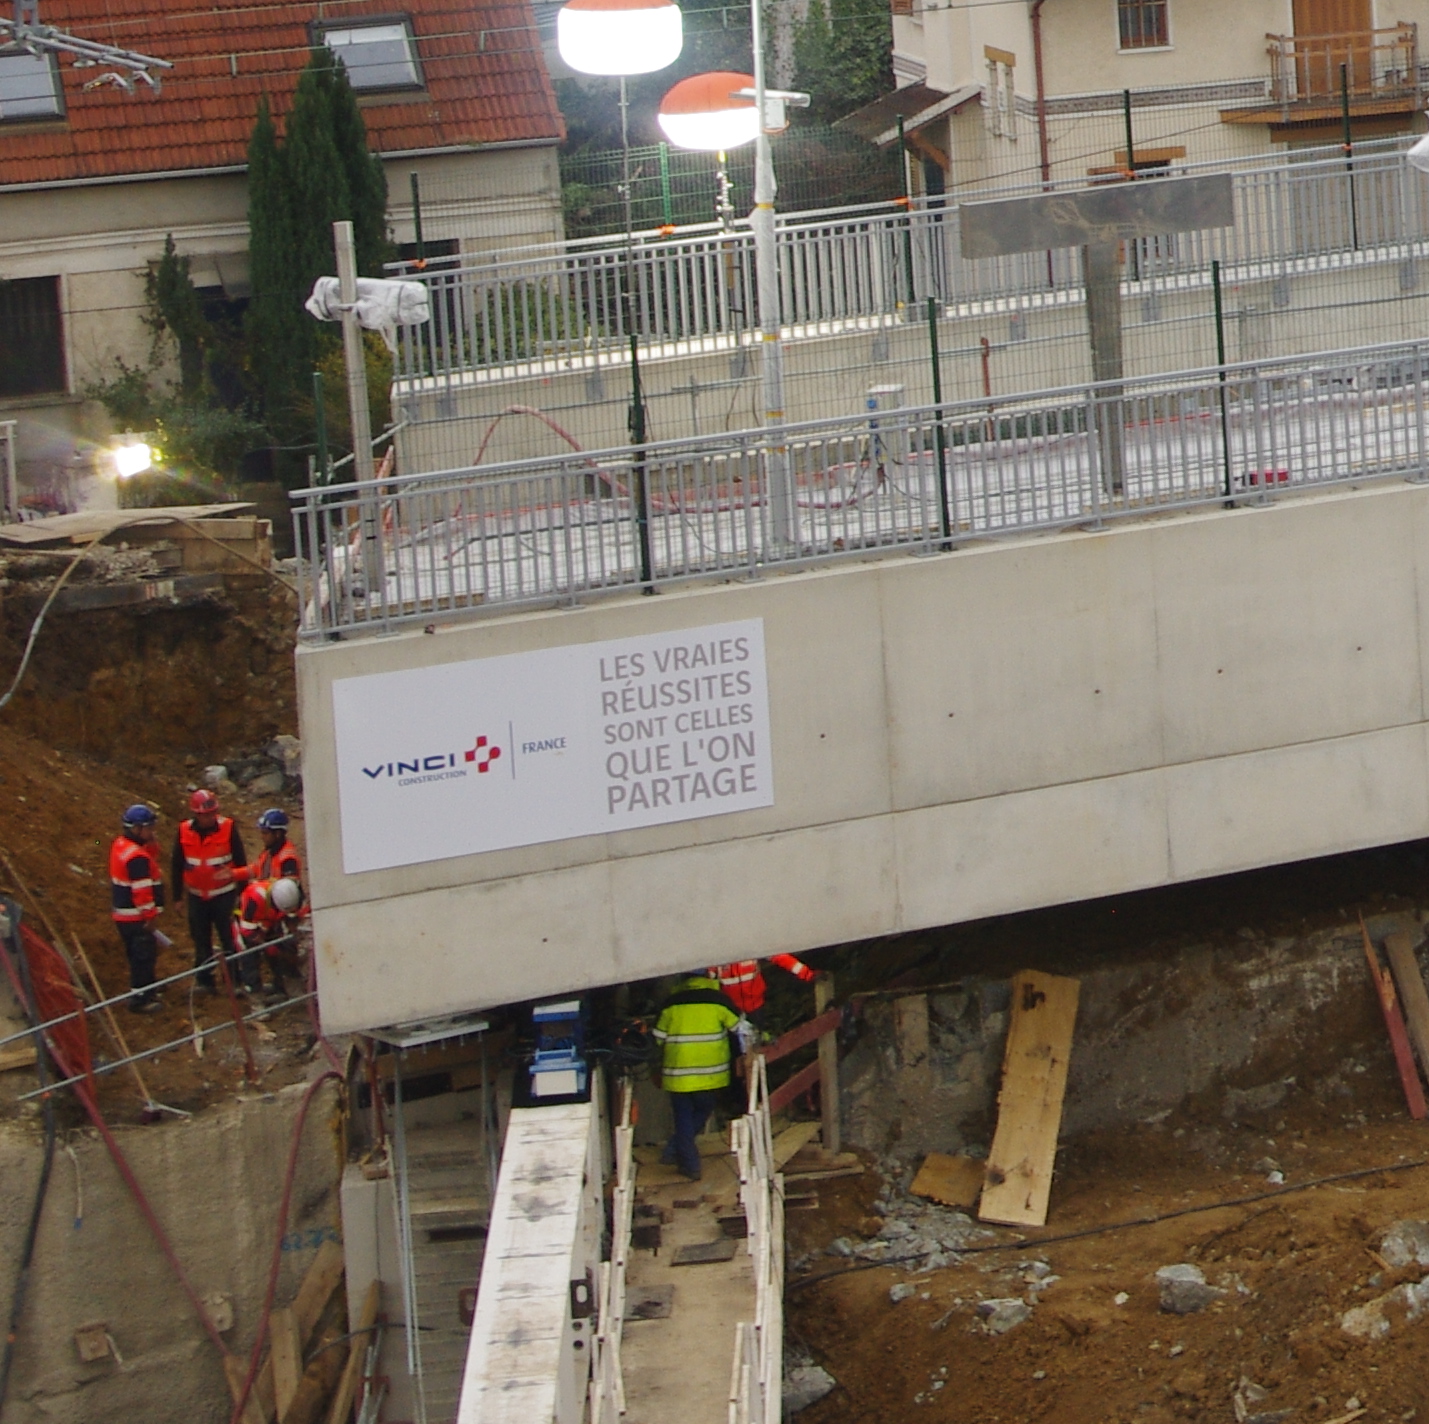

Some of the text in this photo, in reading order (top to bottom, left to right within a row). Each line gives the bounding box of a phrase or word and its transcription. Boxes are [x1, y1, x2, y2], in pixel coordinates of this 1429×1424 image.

[599, 637, 749, 682] LES VRAIES
[602, 670, 752, 716] RÉUSSITES
[603, 703, 753, 744] SONT CELLES
[361, 754, 455, 780] VINCI
[522, 736, 567, 755] FRANCE
[605, 731, 756, 780] QUE L'ON
[398, 769, 467, 787] CONSTRUCTION
[607, 764, 758, 815] PARTAGE
